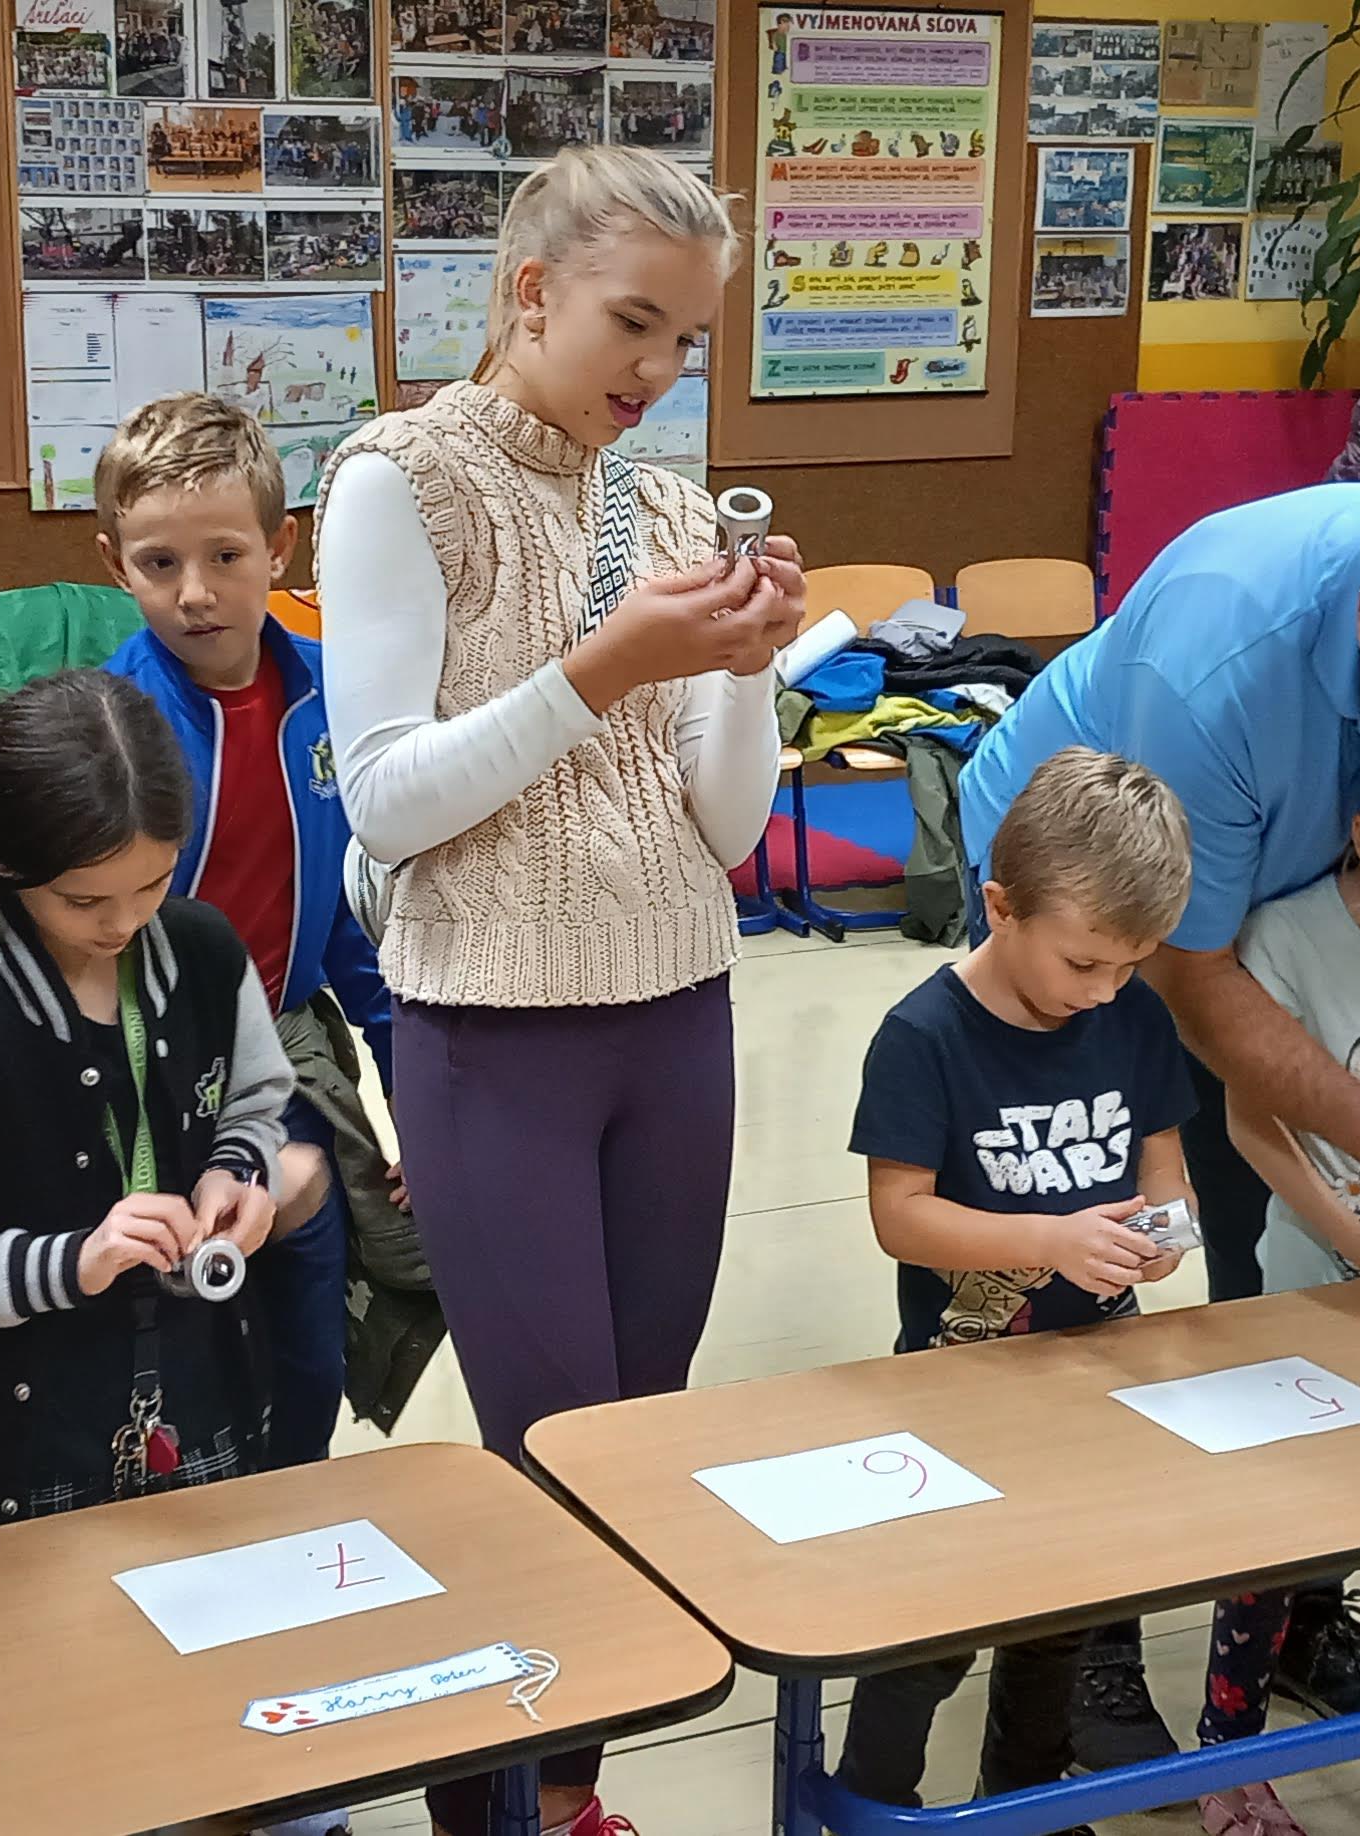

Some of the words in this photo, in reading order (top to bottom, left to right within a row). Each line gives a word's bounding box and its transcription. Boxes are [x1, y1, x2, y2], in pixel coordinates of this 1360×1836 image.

[796, 14, 921, 32] VYJMENOVANÁ
[926, 17, 977, 33] SLOVA
[771, 163, 787, 181] M
[773, 211, 784, 228] P
[792, 275, 805, 292] S
[769, 318, 782, 335] V
[768, 360, 781, 377] Z
[972, 1090, 1131, 1151] STAR
[976, 1128, 1132, 1195] WARS
[1274, 1378, 1345, 1420] 5.
[307, 1542, 386, 1590] 7.
